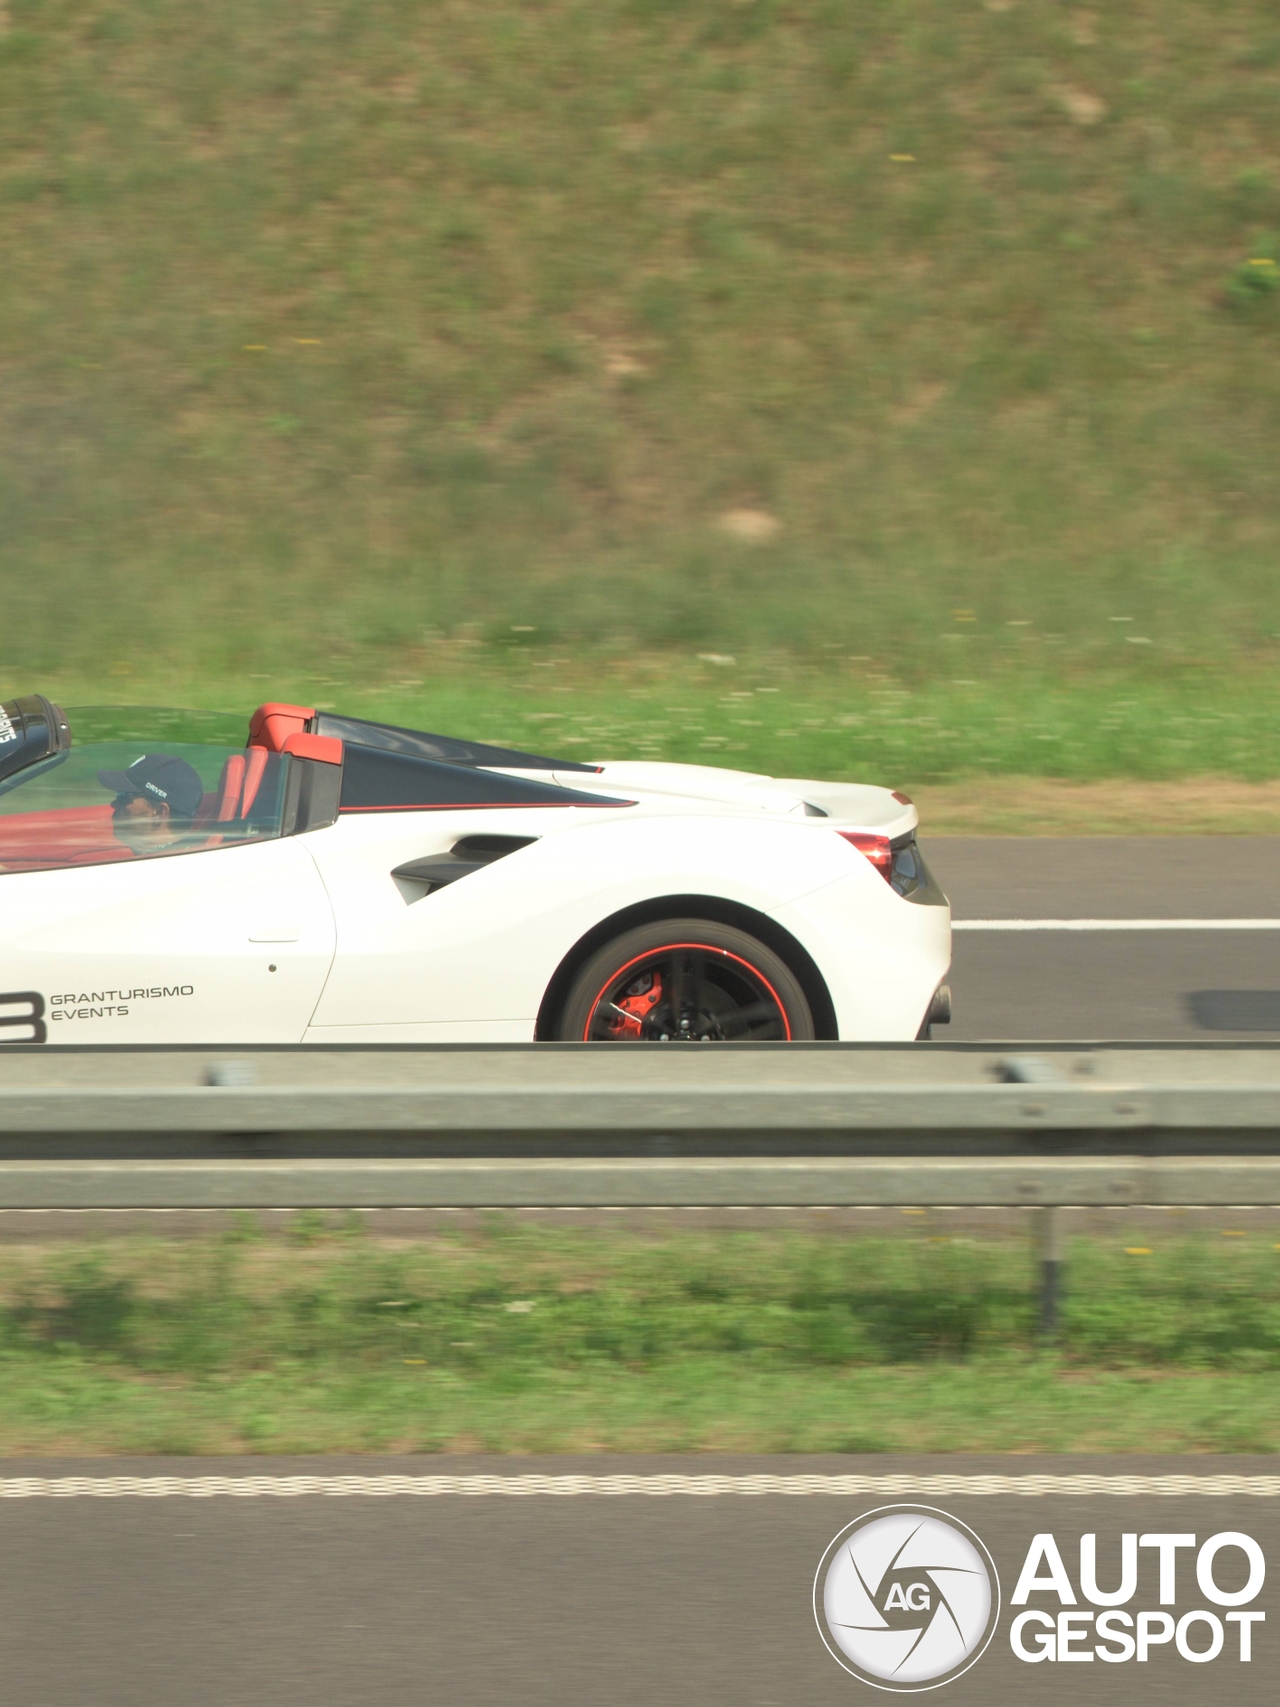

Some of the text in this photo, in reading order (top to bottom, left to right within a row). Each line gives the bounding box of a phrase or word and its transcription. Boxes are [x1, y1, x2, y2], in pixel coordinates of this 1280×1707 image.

[145, 782, 167, 799] DRIVER
[50, 985, 194, 1005] GRANTURISMO
[51, 1005, 129, 1021] EVENTS
